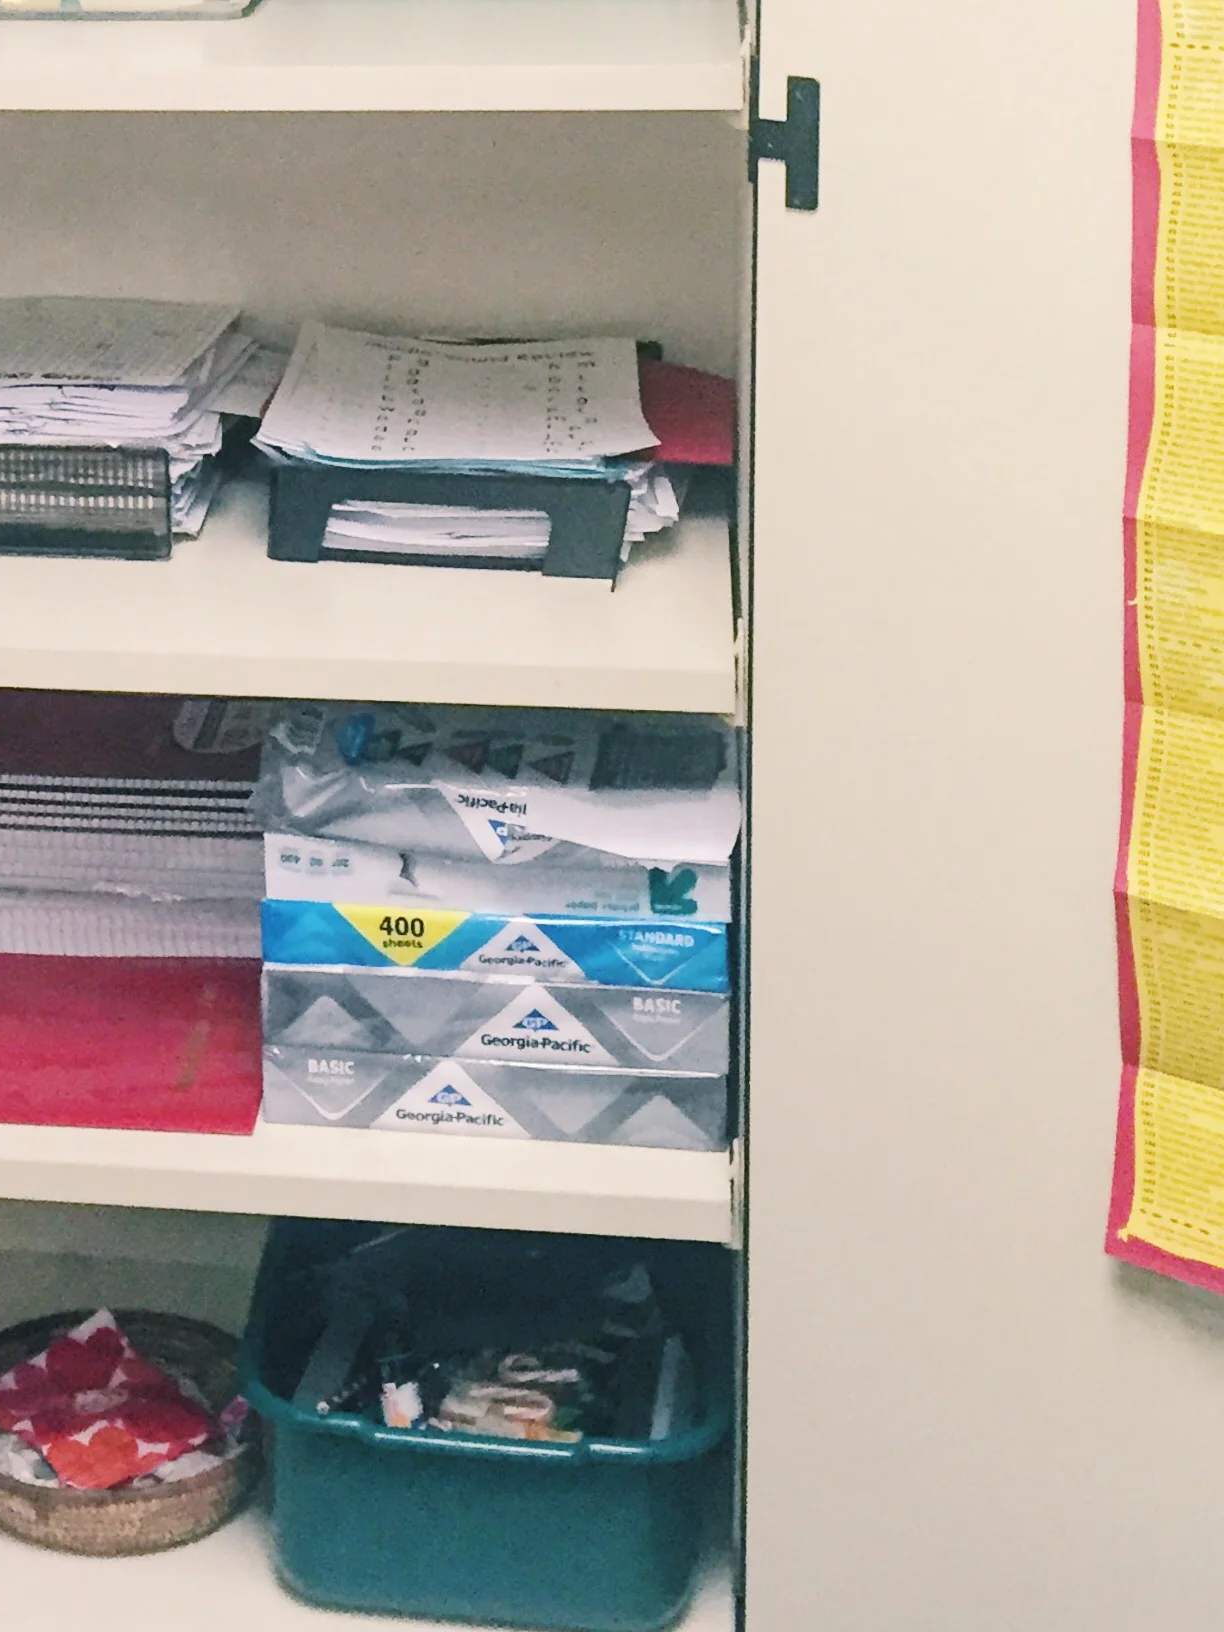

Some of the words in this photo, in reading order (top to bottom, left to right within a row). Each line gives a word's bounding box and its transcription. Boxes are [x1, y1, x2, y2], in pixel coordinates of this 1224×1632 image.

[379, 916, 425, 938] 400
[382, 937, 424, 949] sheets
[619, 930, 695, 948] STANDARD
[478, 954, 568, 968] Georgia-Pacific
[632, 996, 682, 1014] BASIC
[522, 1018, 550, 1030] GP
[480, 1033, 592, 1054] Georgia-Pacific
[307, 1059, 354, 1075] BASIC
[437, 1092, 463, 1104] GP
[395, 1108, 504, 1126] Georgia-Pacific
